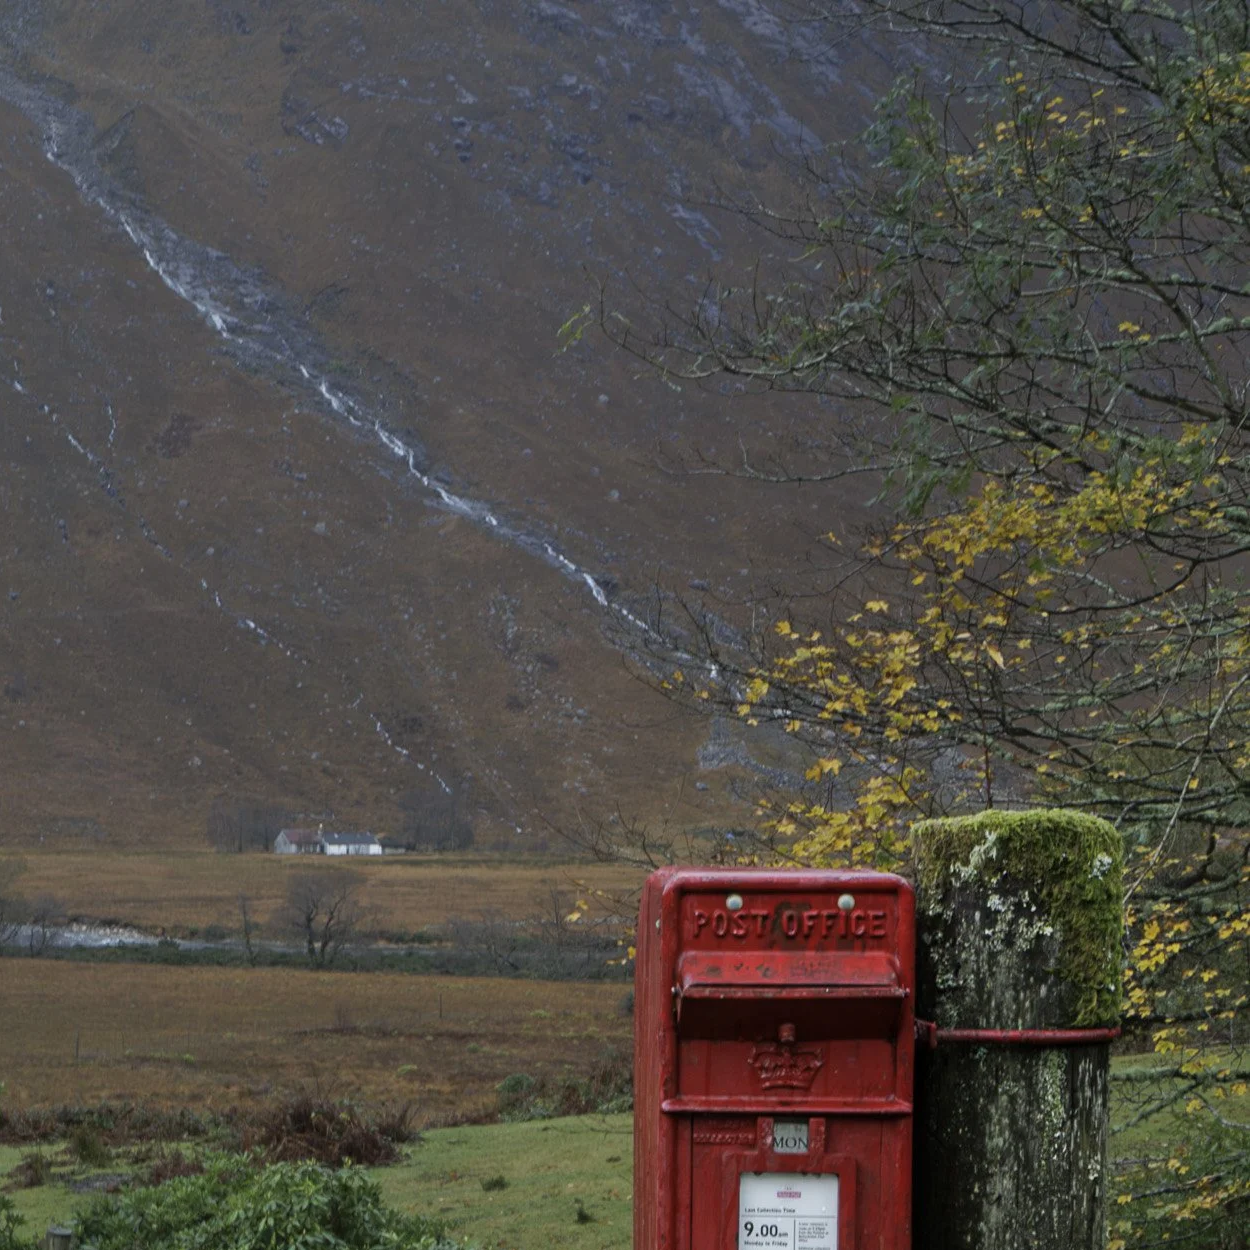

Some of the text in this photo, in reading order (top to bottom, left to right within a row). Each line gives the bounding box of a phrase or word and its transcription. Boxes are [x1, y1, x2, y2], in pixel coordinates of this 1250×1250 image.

[693, 909, 887, 938] POST OFFICE
[773, 1137, 809, 1148] MON
